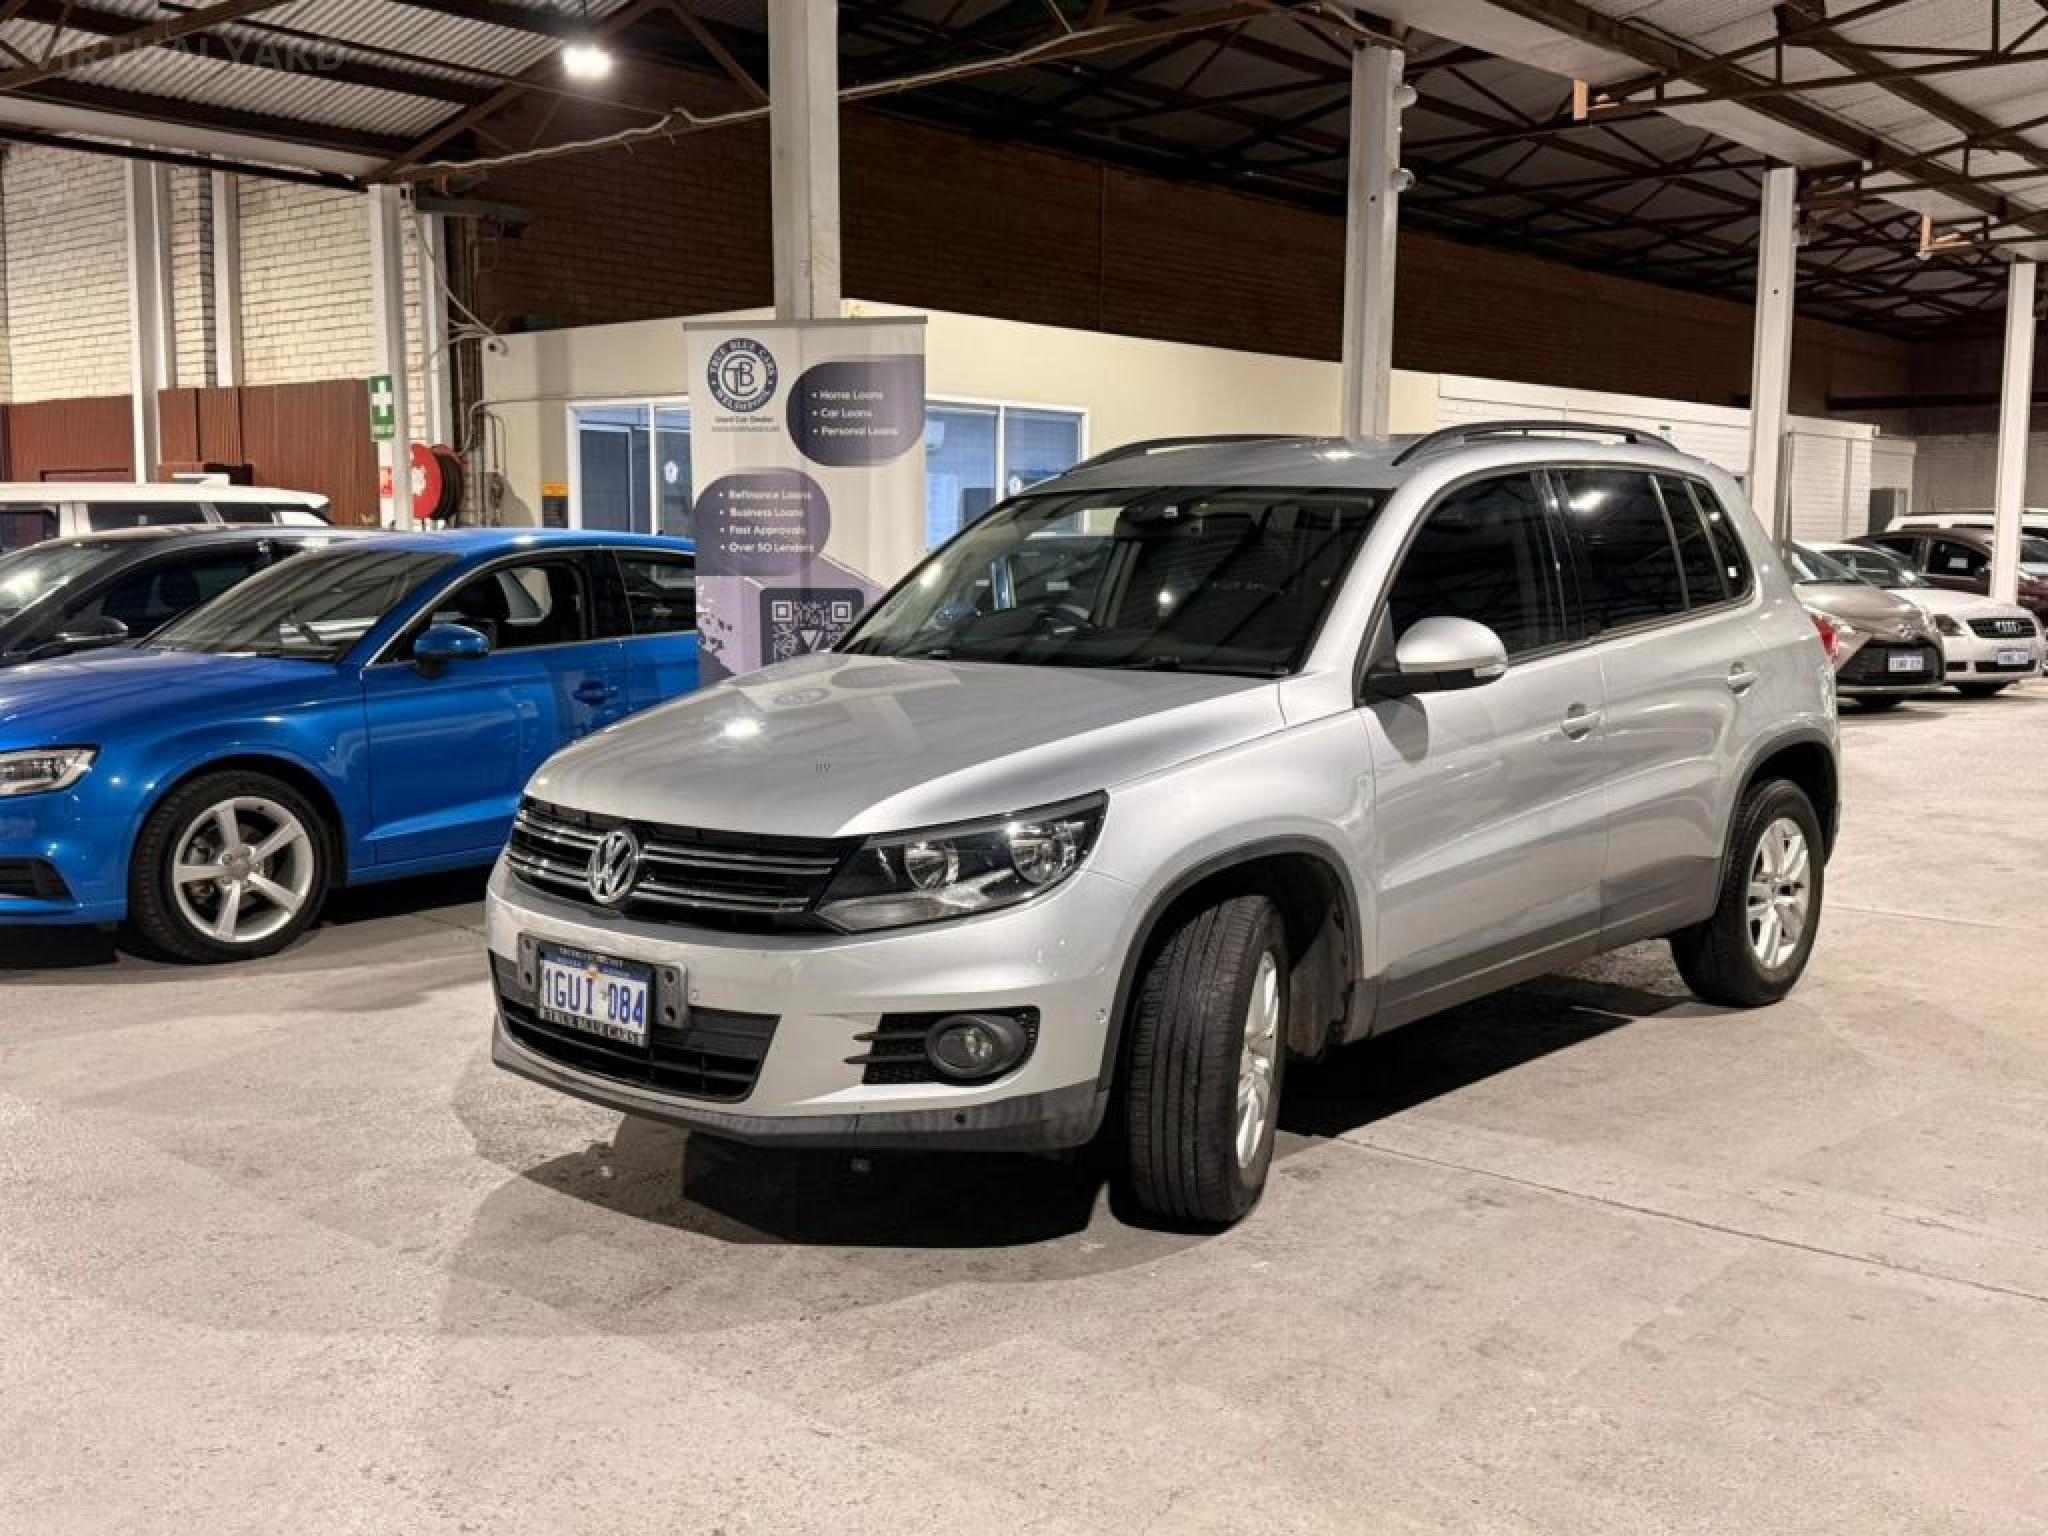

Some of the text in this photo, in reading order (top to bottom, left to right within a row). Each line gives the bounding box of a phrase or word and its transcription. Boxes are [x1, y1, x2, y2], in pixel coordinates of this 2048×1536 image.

[820, 390, 883, 400] Home Loans
[820, 408, 872, 417] Car Loans
[821, 426, 898, 436] Personal Loans
[729, 507, 804, 517] Business Loans
[729, 525, 751, 535] Fast
[729, 542, 815, 552] Over 50 Lenders
